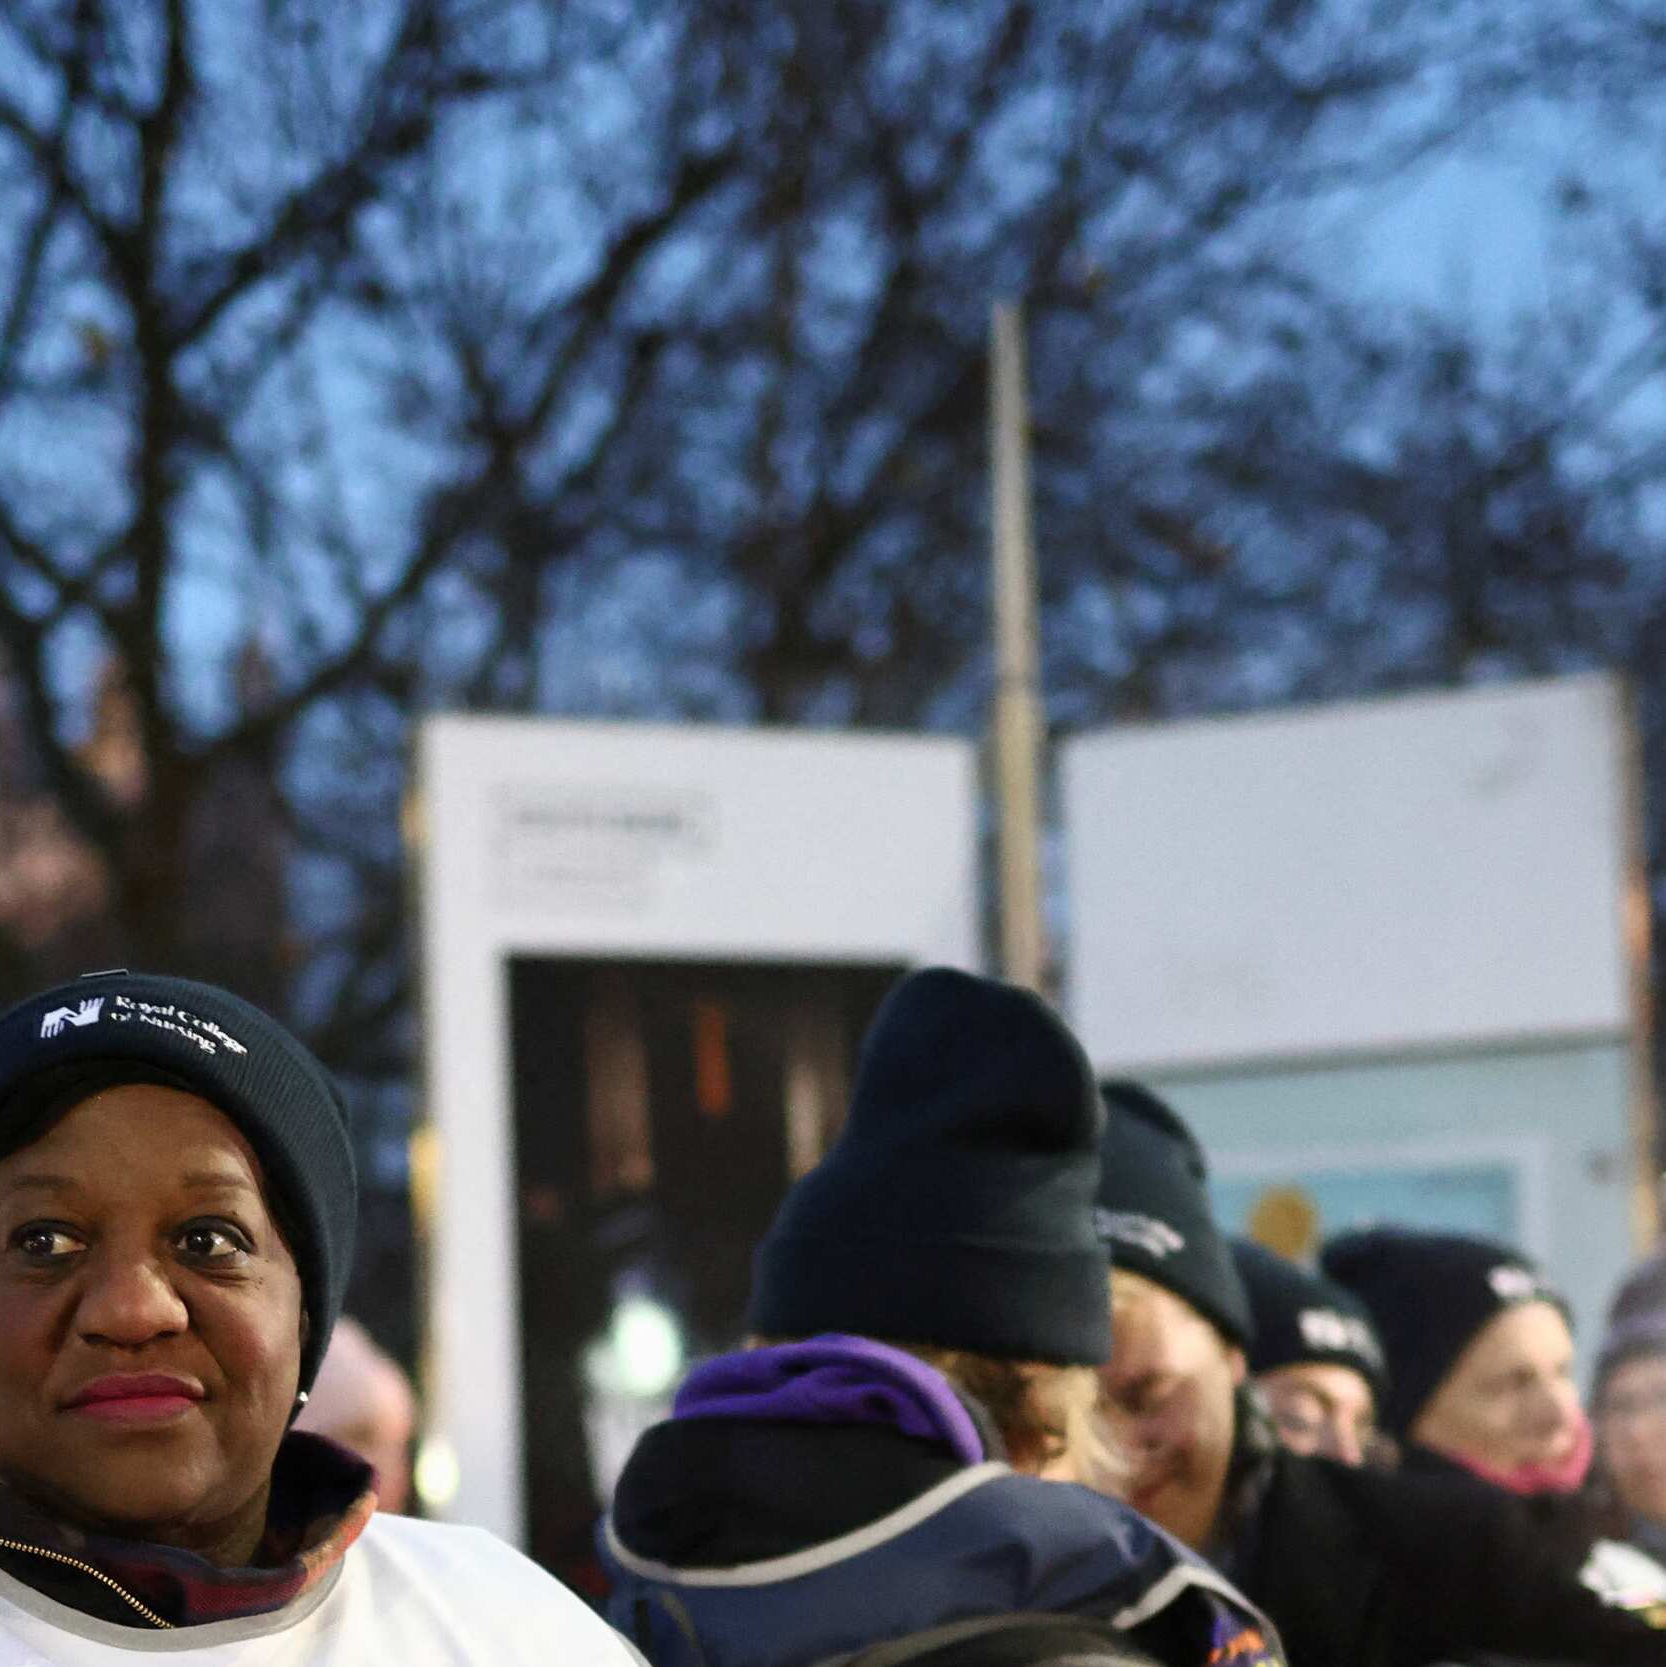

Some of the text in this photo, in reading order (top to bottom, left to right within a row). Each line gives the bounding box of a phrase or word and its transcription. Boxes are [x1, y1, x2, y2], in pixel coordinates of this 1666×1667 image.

[116, 995, 248, 1057] Royal College
[140, 1012, 217, 1055] Nursing
